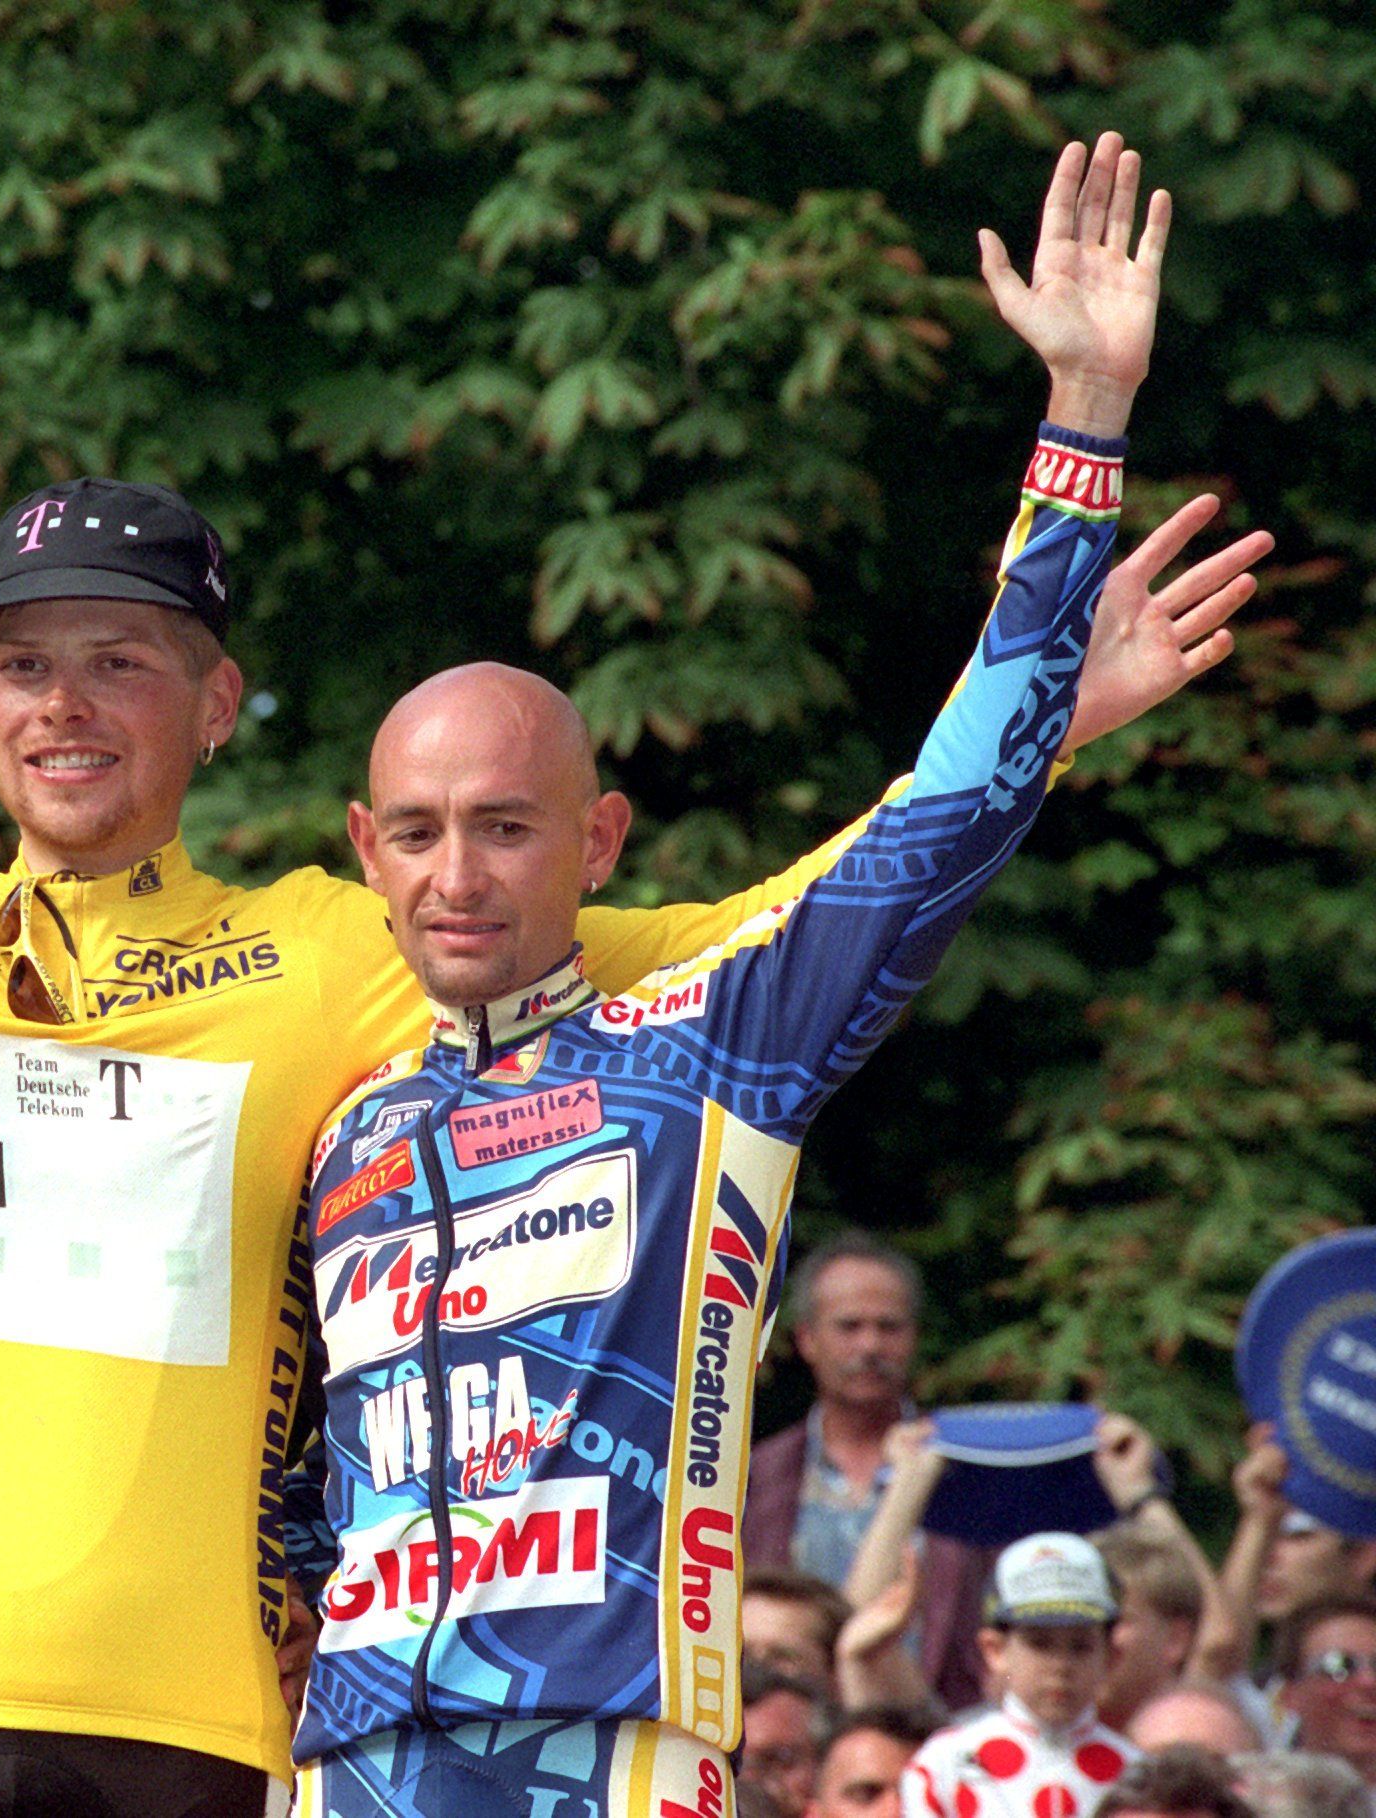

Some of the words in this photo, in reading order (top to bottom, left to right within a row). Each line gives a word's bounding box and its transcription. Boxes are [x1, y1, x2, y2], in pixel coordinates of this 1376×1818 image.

[17, 499, 67, 554] T
[15, 1052, 58, 1073] Team
[17, 1075, 91, 1098] Deutsche
[99, 1059, 142, 1120] T
[17, 1096, 84, 1118] Telekom
[453, 1086, 596, 1134] magniflex
[475, 1117, 587, 1162] materassi
[323, 1196, 616, 1324] Mercatone
[392, 1285, 487, 1337] Uno
[686, 1170, 767, 1488] Mercatone
[460, 1389, 579, 1497] HOME
[326, 1508, 599, 1622] GIRMI
[682, 1506, 734, 1633] Uno
